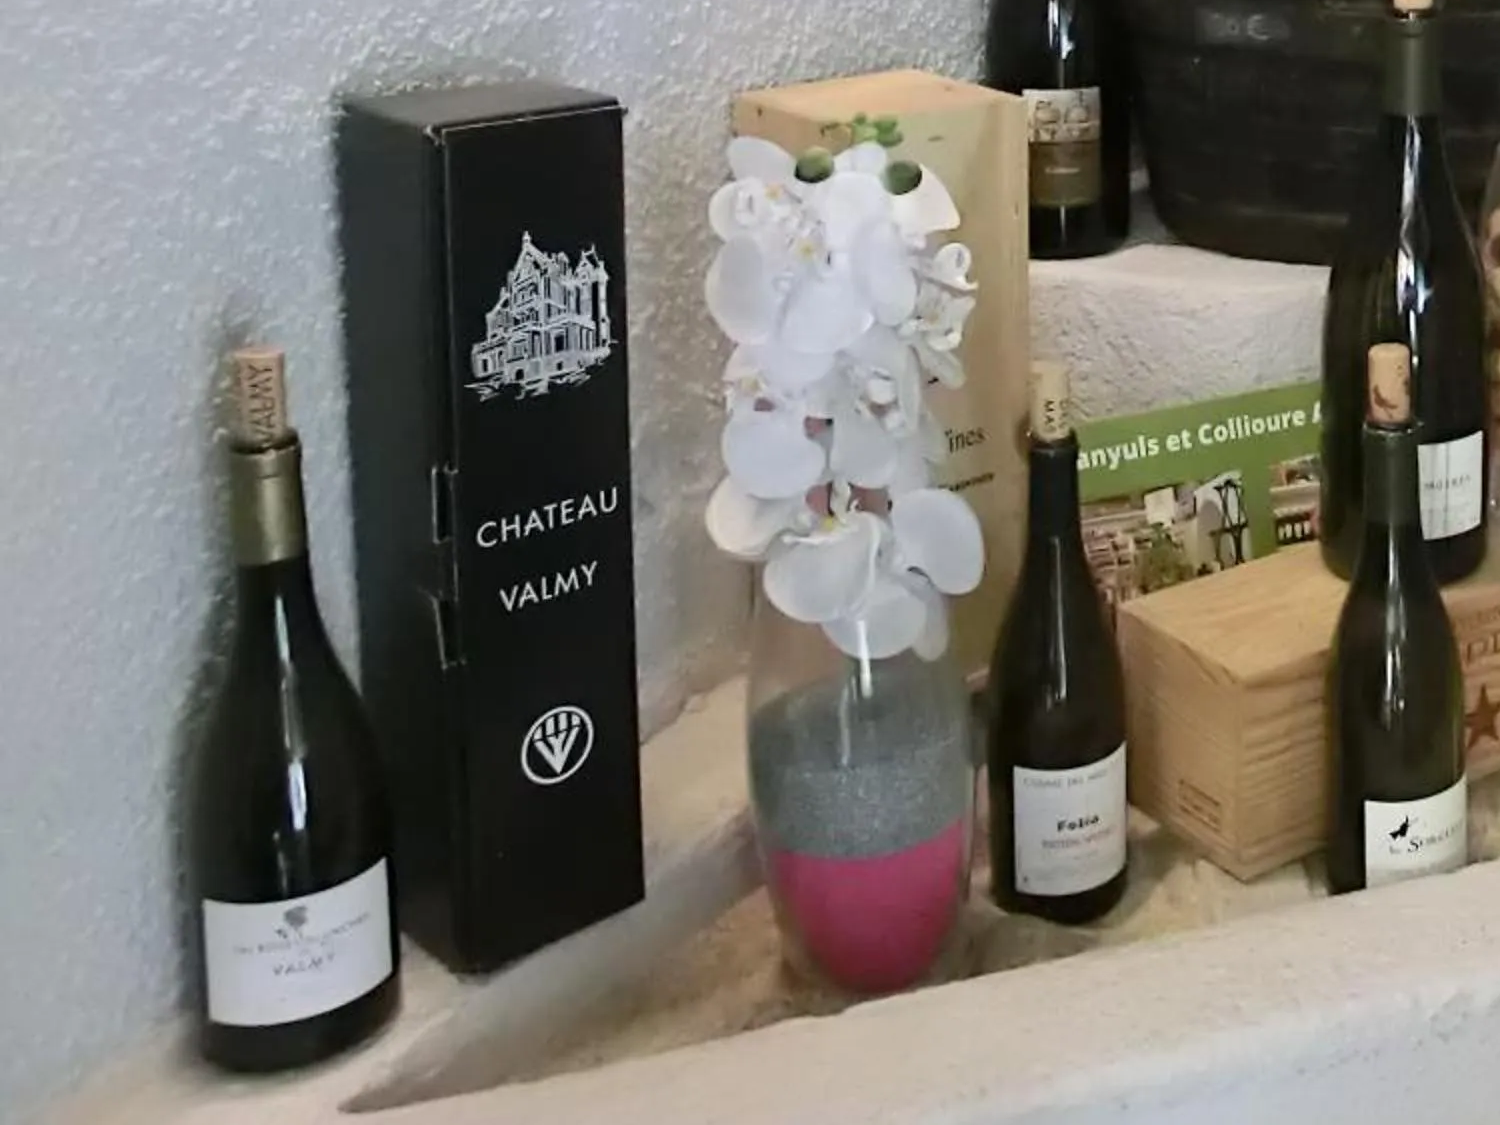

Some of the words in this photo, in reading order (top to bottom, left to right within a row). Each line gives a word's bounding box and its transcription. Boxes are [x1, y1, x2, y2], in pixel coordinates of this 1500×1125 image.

[1076, 434, 1160, 471] anyuls
[1166, 430, 1193, 453] et
[1198, 409, 1306, 446] Collioure
[476, 487, 618, 548] CHATEAU
[500, 561, 598, 613] VALMY
